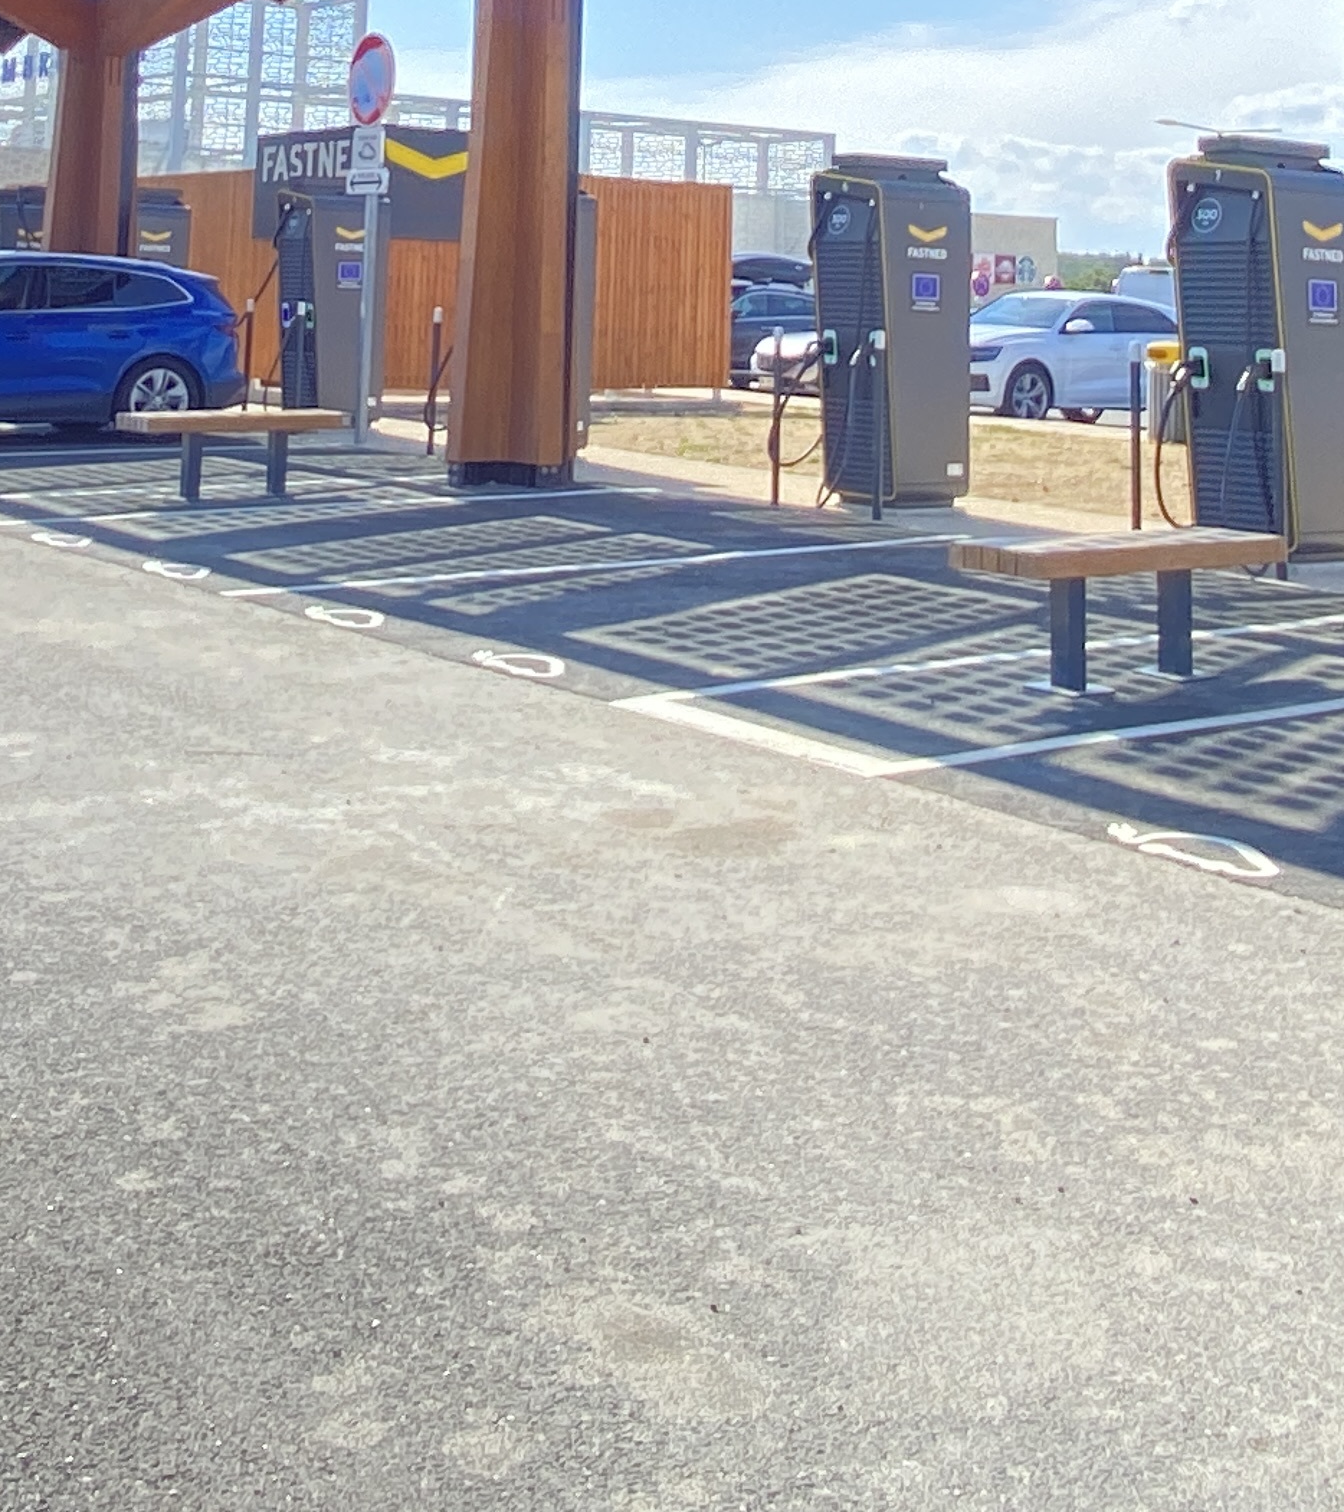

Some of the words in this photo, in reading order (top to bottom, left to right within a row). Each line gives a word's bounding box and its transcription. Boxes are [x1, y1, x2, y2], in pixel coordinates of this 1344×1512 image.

[262, 140, 351, 182] FASTNE
[907, 246, 948, 260] FASTNED
[1302, 246, 1344, 263] FASTNED
